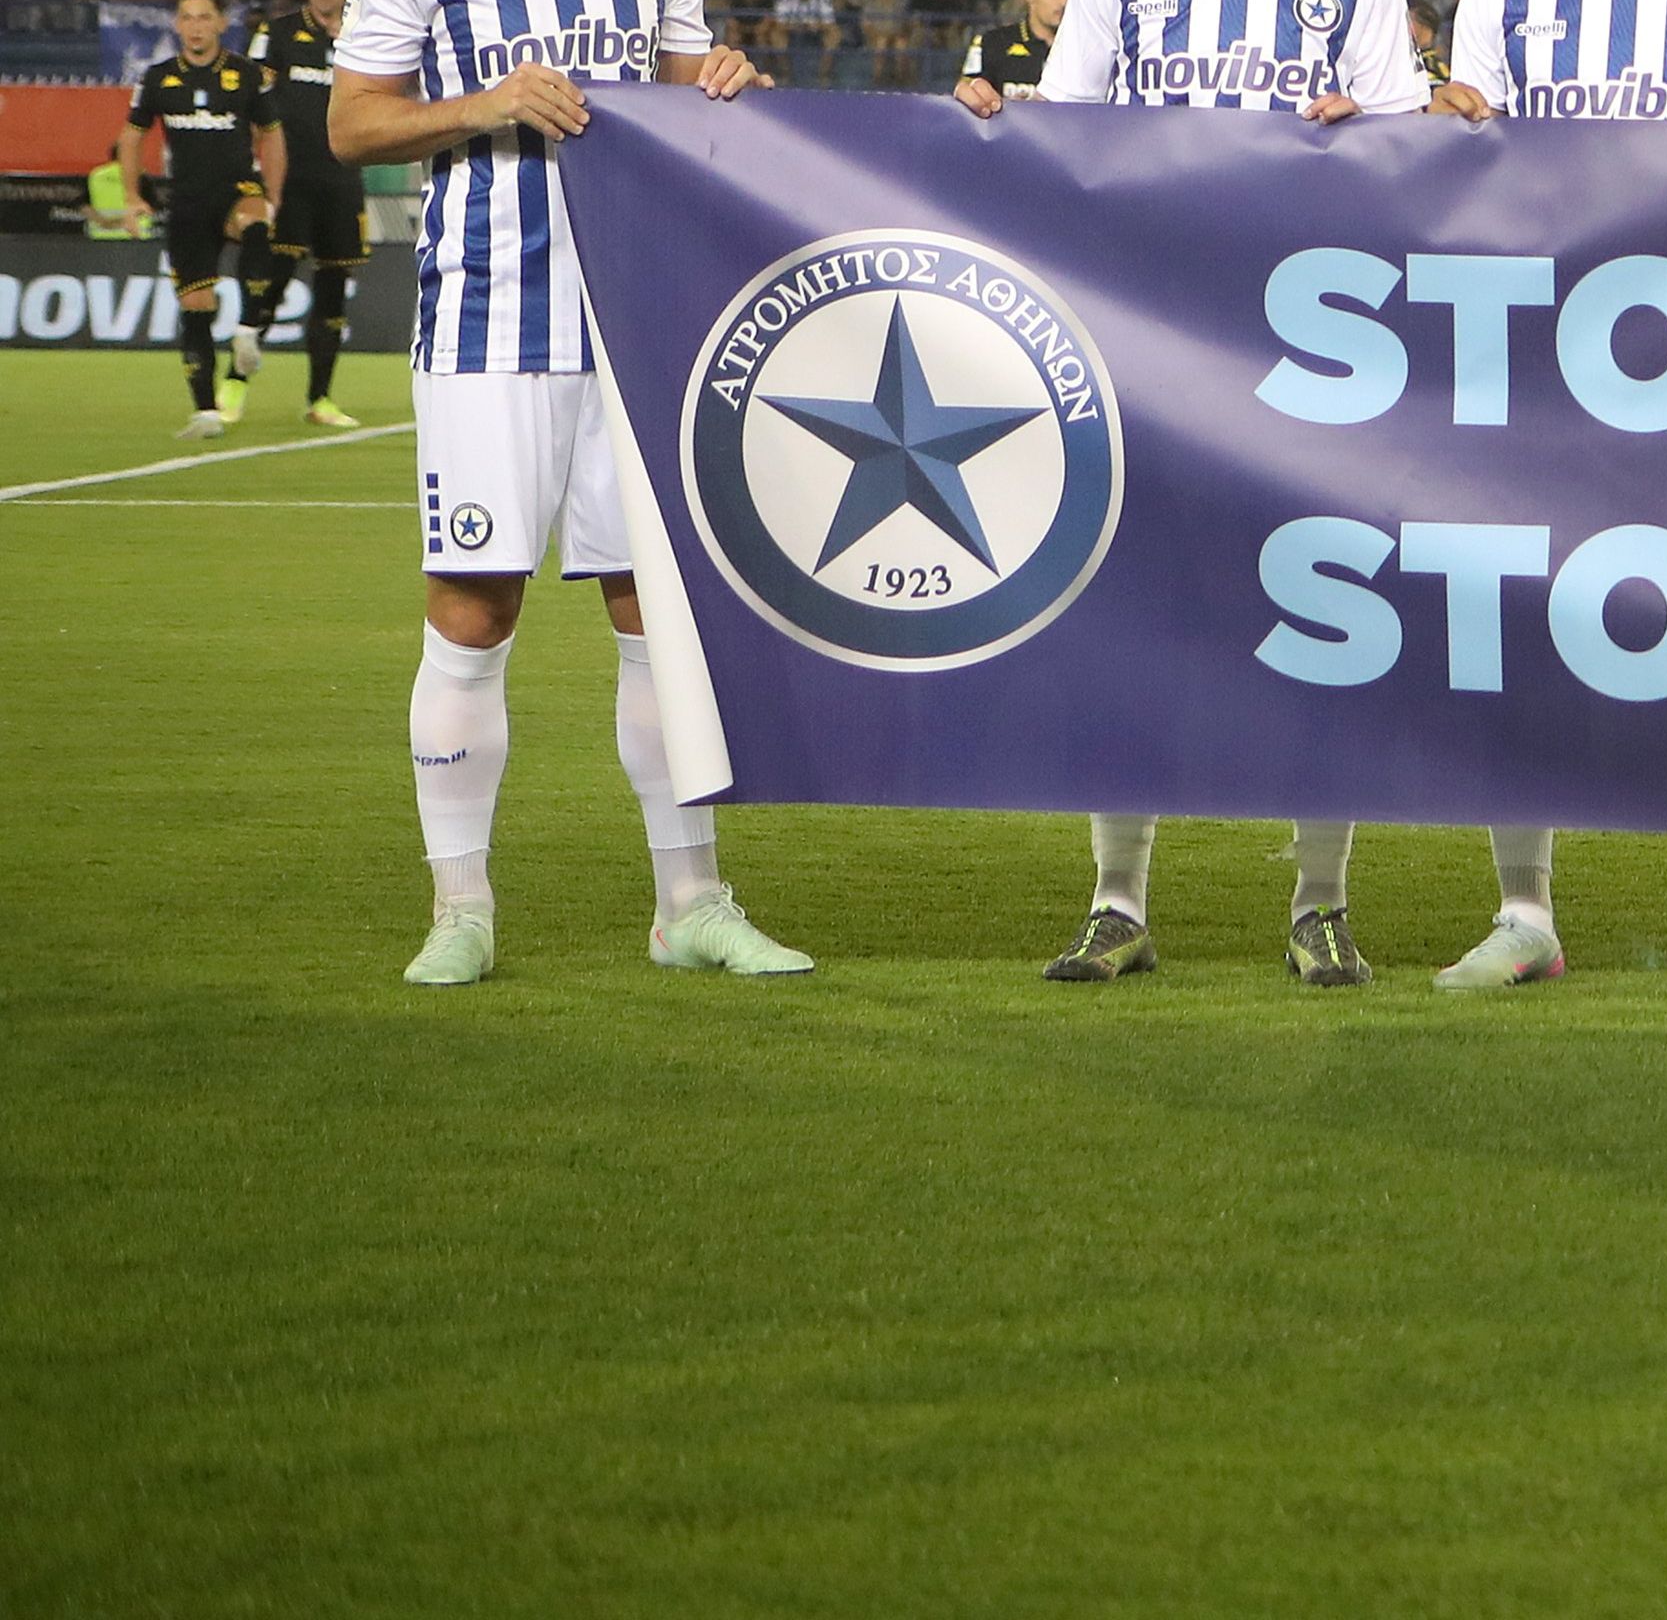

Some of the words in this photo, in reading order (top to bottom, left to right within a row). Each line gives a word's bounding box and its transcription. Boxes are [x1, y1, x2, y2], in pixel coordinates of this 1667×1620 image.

[1128, 0, 1176, 13] capelli
[480, 18, 658, 78] novibet
[1142, 46, 1328, 99] novibet
[711, 248, 941, 410] ΑΤΡΟΜΗΤΟΣ
[946, 264, 1100, 423] ΑΘΗΝΩΝ
[862, 563, 953, 599] 1923
